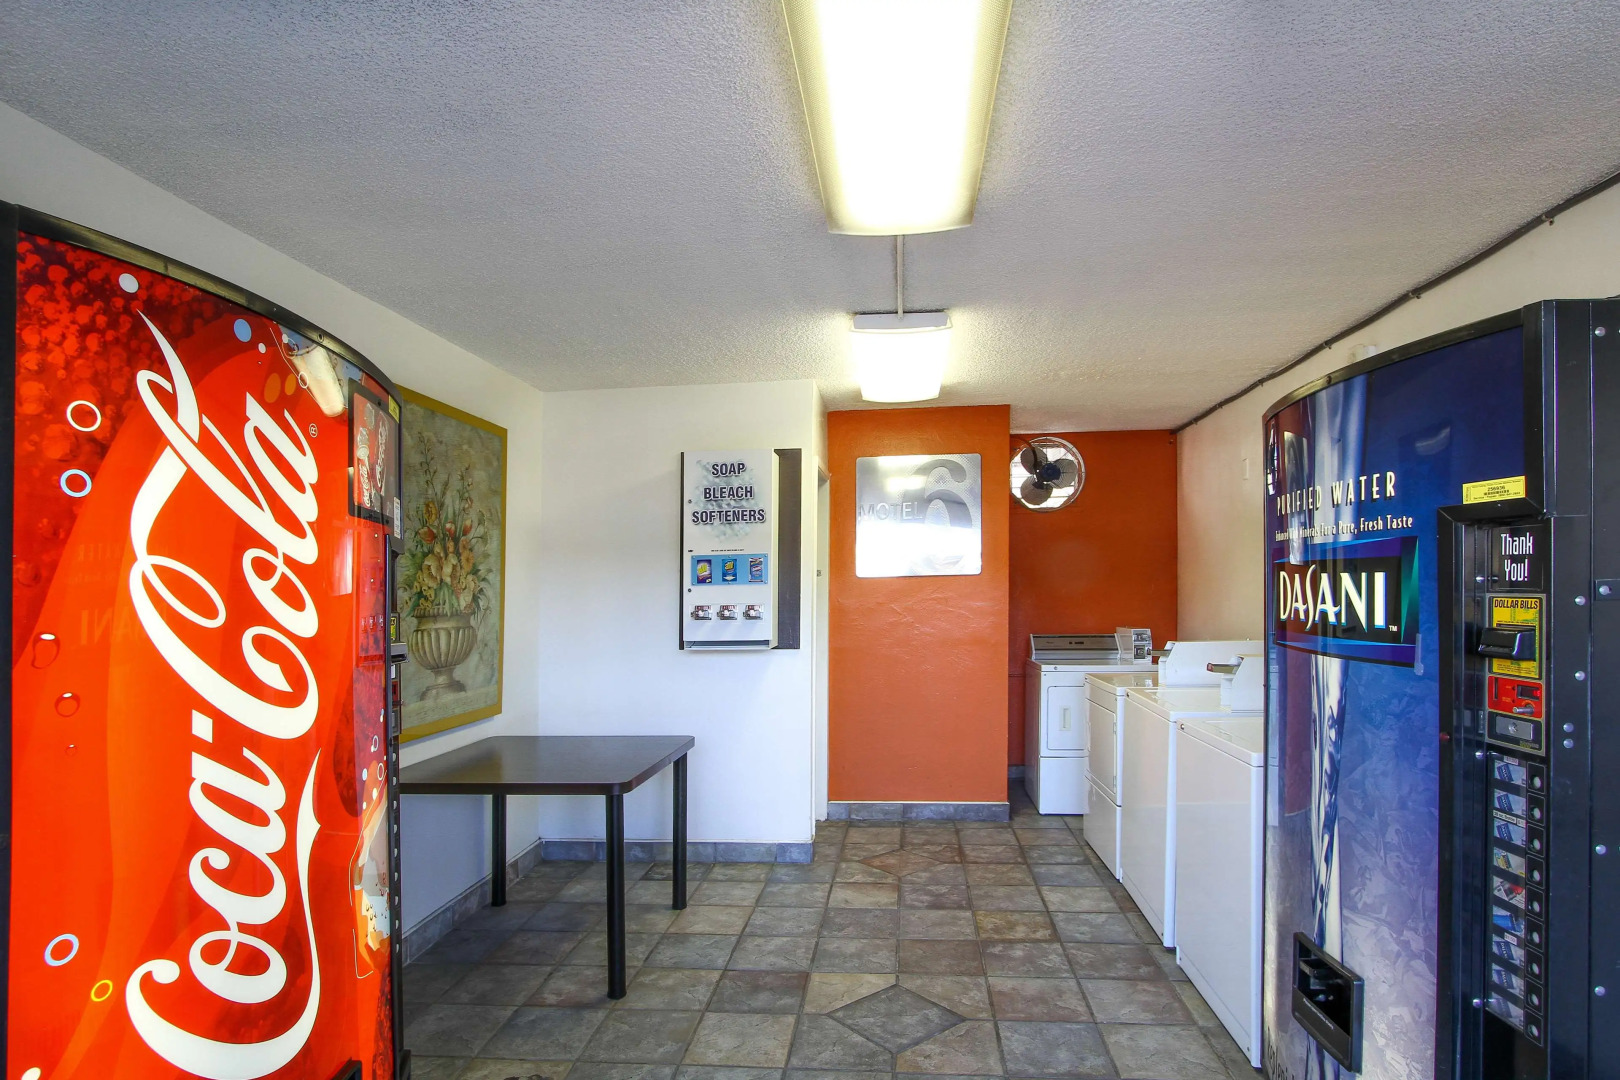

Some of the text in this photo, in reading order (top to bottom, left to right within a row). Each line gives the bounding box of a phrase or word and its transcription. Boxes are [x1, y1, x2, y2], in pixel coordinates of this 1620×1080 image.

[711, 462, 746, 477] SOAP
[703, 485, 753, 500] BLEACH
[1277, 471, 1396, 516] PURIFIED WATER
[692, 508, 766, 524] SOFTENERS
[858, 501, 923, 521] MOTEL
[1338, 520, 1358, 535] Pure,
[1360, 515, 1383, 532] Fresh
[1386, 514, 1413, 530] Taste
[1500, 532, 1534, 555] Thank
[1504, 558, 1528, 581] You!
[1279, 564, 1387, 633] DASANI
[1494, 598, 1539, 610] DOLLAR BILLS
[126, 309, 321, 1080] Coca-Cola
